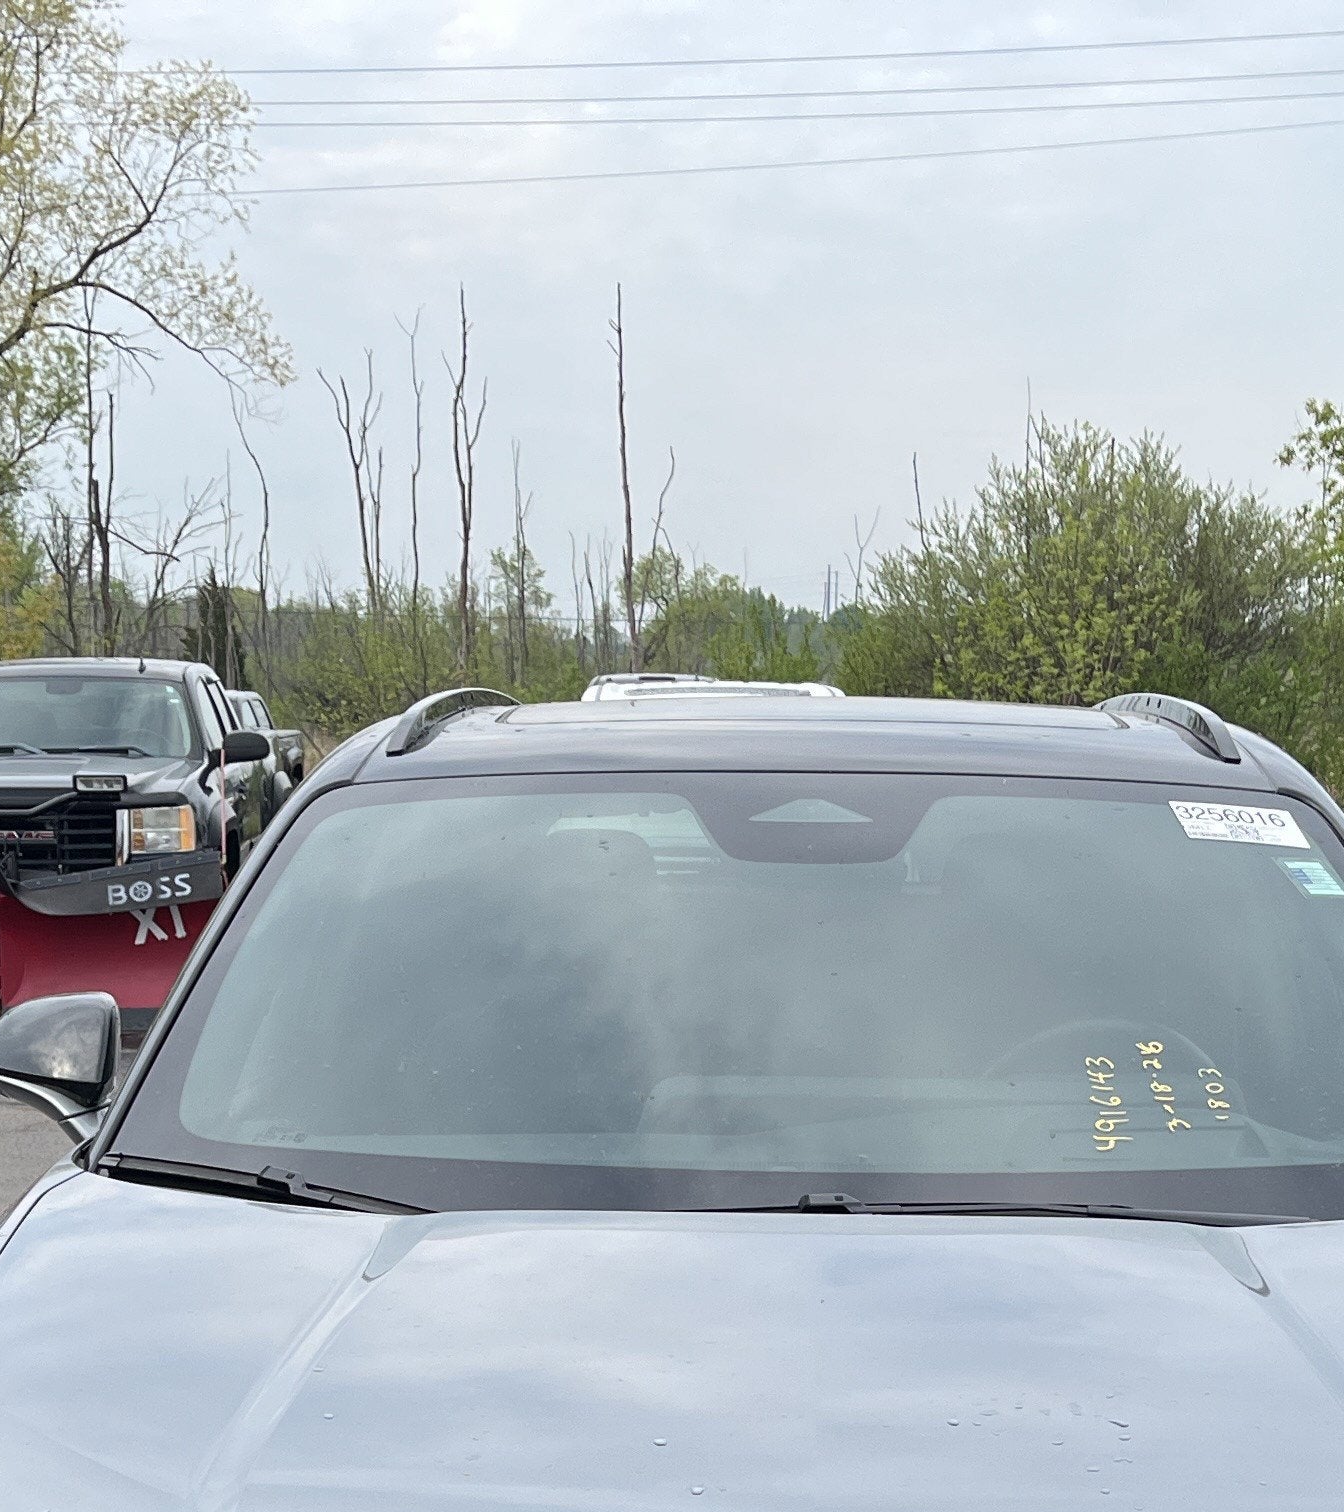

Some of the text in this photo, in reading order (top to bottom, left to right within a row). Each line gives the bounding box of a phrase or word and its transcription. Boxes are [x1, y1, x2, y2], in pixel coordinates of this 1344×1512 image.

[1175, 805, 1286, 828] 3256016
[107, 872, 192, 906] BOSS
[1085, 1056, 1134, 1152] 4916143
[1197, 1068, 1231, 1120] 1803
